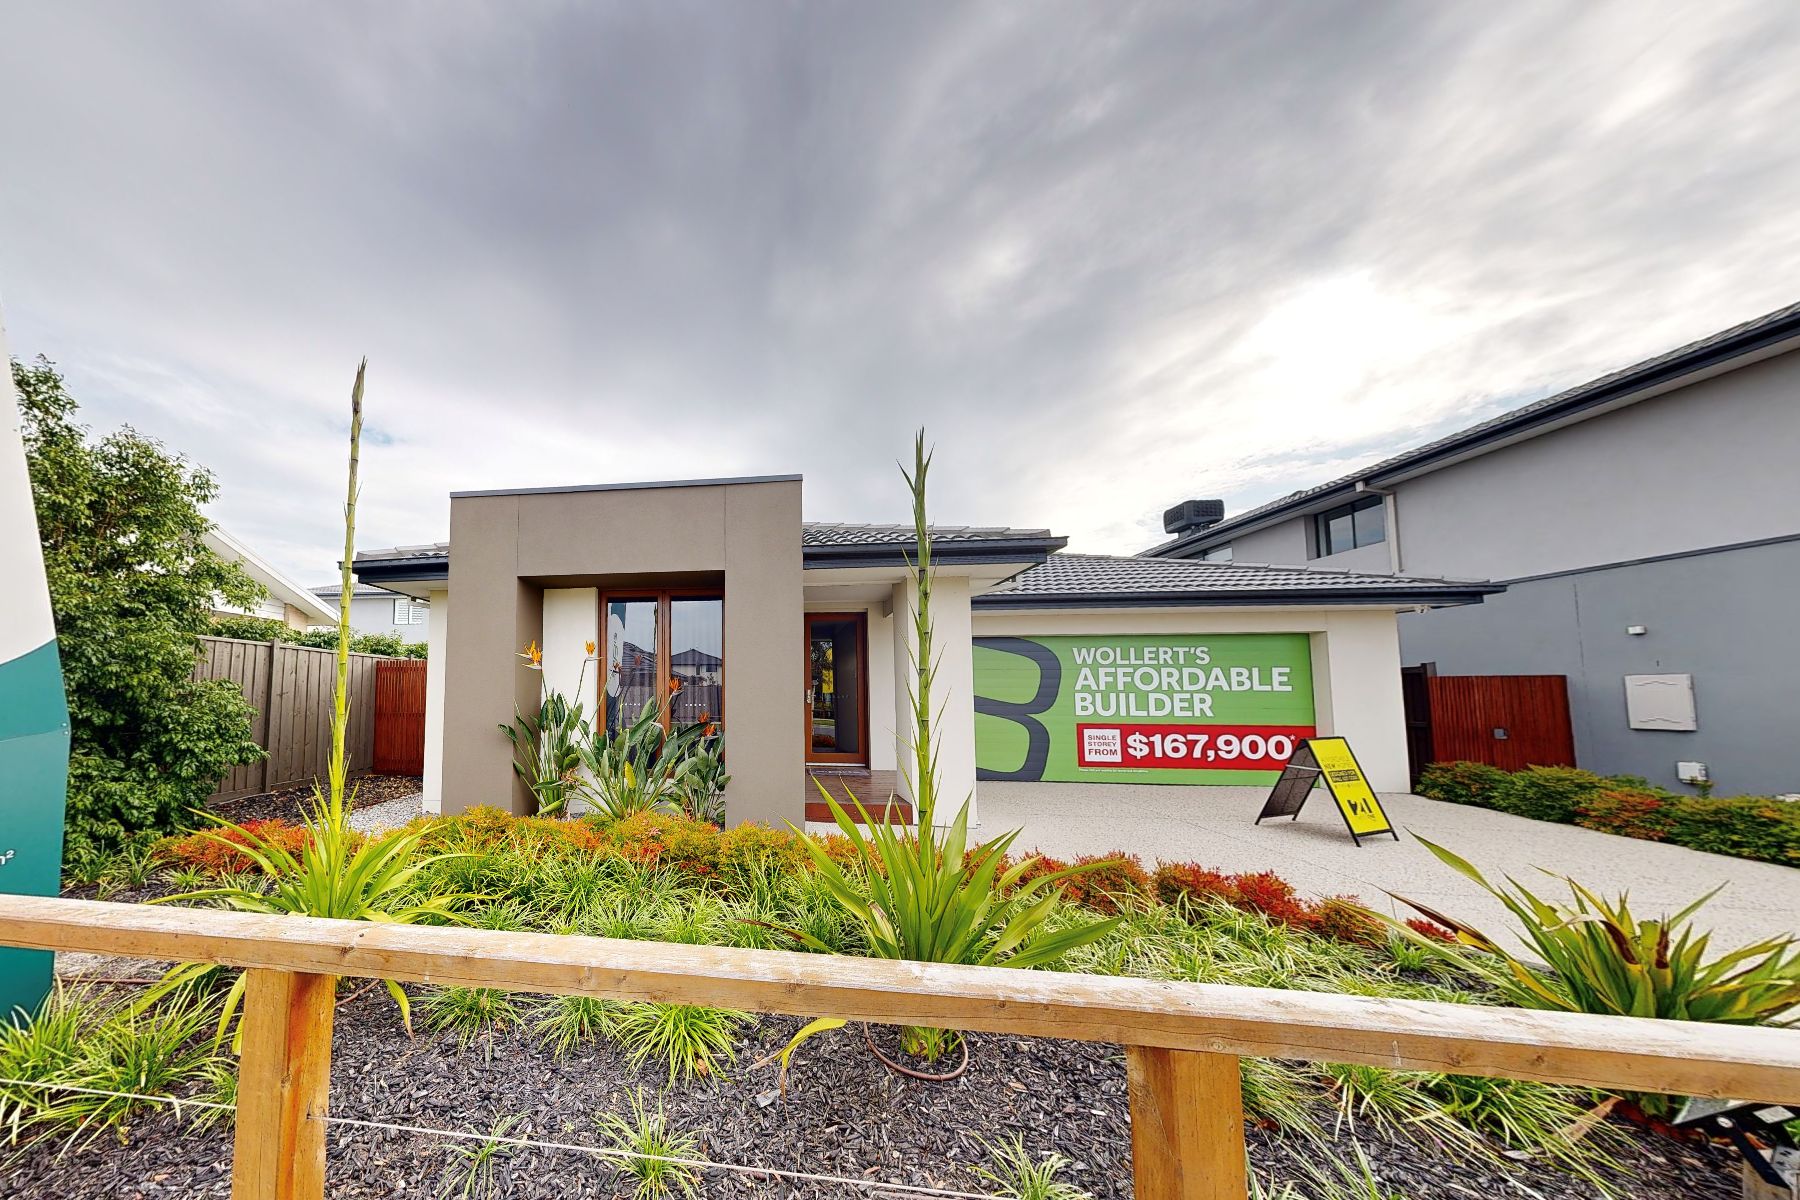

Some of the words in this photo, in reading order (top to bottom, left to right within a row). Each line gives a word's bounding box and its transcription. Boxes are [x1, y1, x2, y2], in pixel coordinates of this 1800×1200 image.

[1072, 646, 1211, 665] WOLLERT'S
[1074, 667, 1293, 692] AFFORDABLE
[1074, 692, 1214, 717] BUILDER
[1088, 748, 1118, 756] FROM
